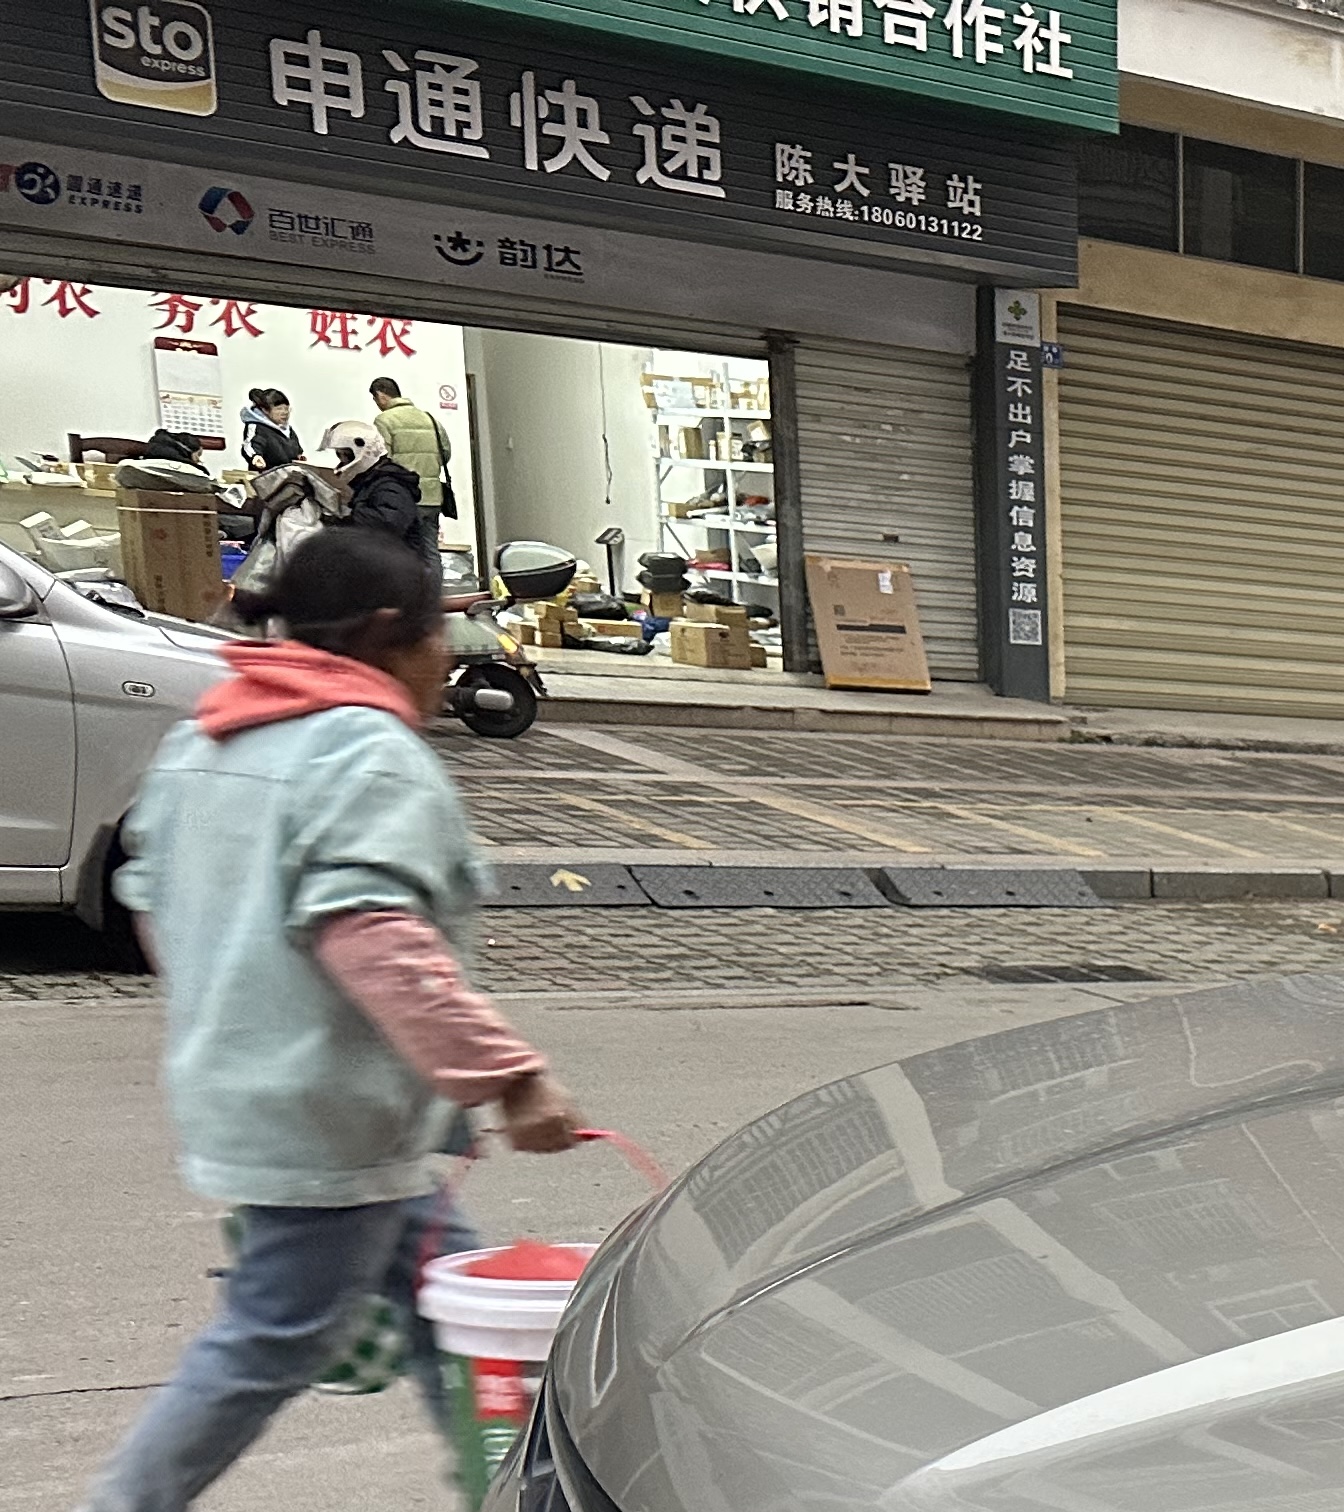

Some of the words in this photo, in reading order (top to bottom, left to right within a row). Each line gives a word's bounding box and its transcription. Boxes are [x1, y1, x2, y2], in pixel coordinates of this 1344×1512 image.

[101, 5, 204, 61] sto
[141, 54, 206, 77] express
[269, 28, 727, 199] 申通快递
[774, 141, 983, 217] 陈大驿站
[68, 195, 143, 214] EXPRESS
[268, 207, 375, 243] 百世汇通
[774, 188, 983, 241] 服务热线:18060131122
[269, 229, 307, 246] BEST
[312, 235, 376, 255] EXPRESS
[498, 237, 584, 276] 韵达
[1006, 348, 1038, 604] 足不出户掌握信息资源
